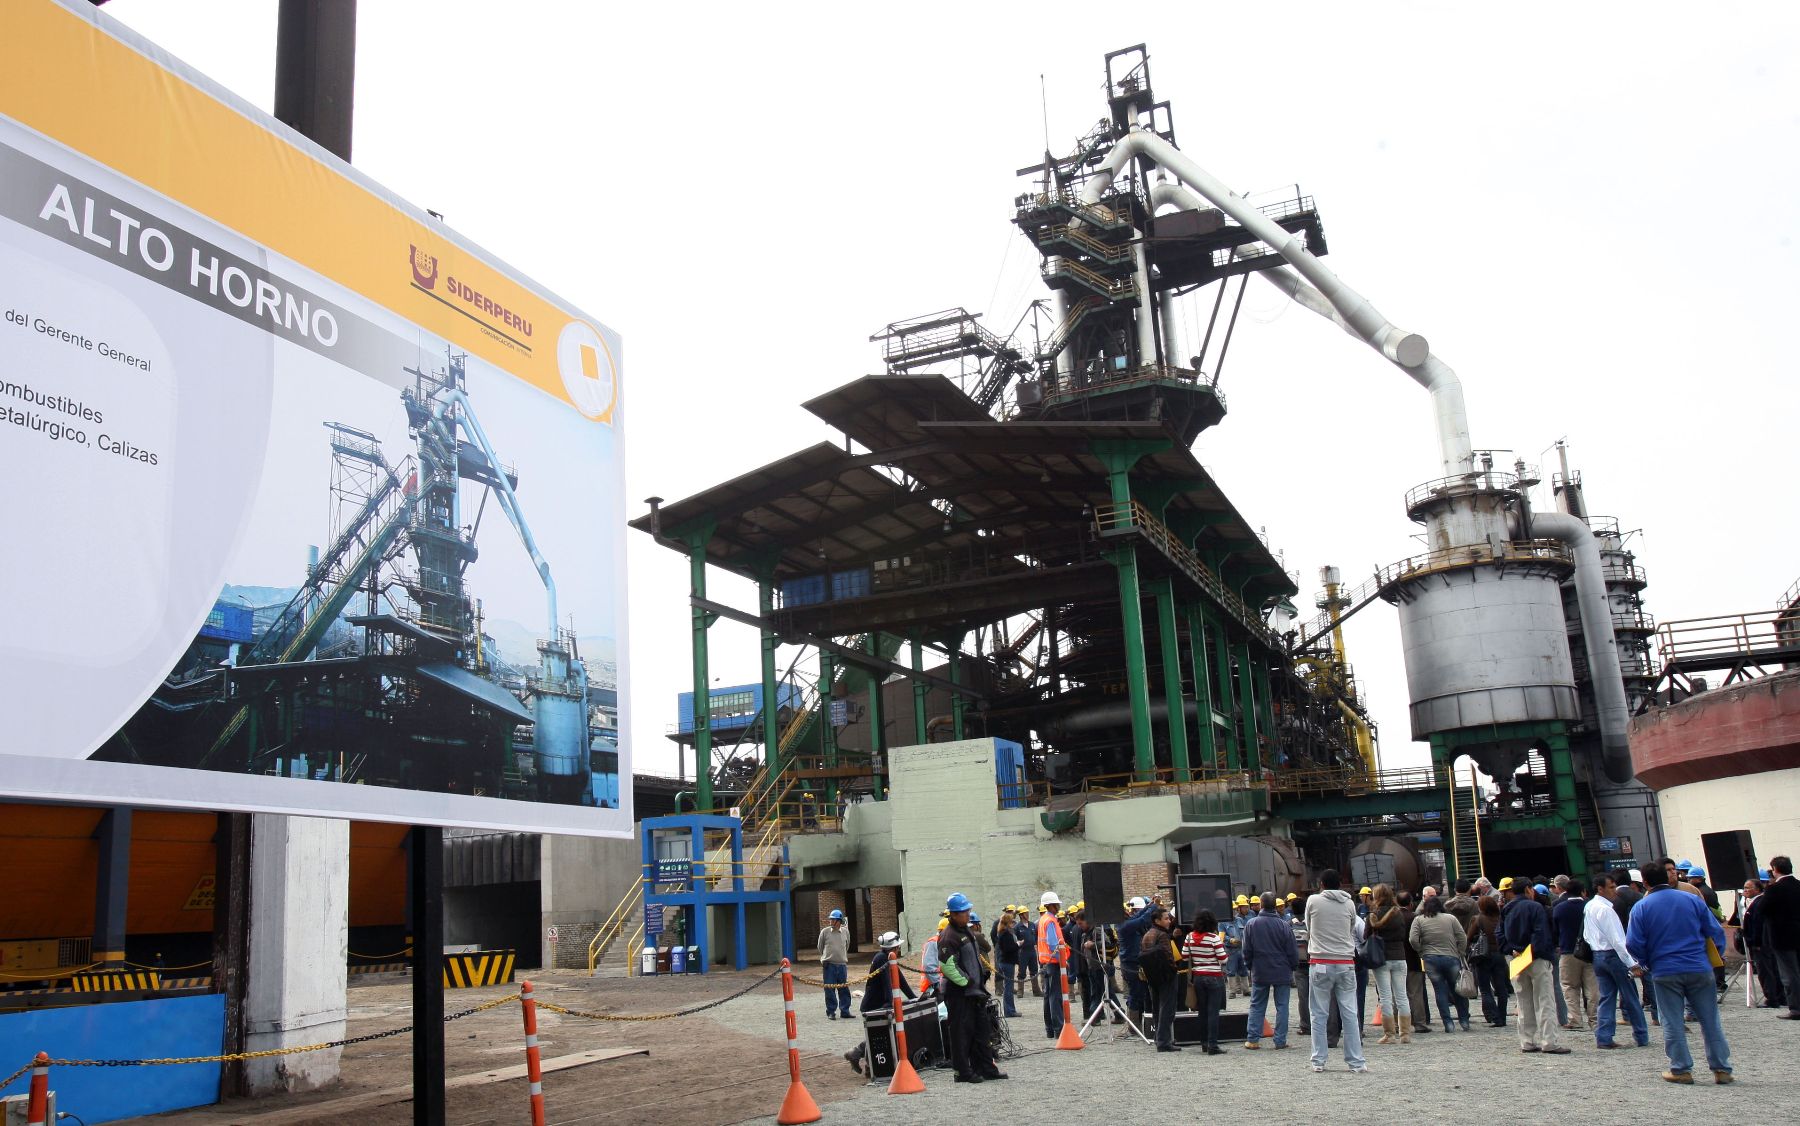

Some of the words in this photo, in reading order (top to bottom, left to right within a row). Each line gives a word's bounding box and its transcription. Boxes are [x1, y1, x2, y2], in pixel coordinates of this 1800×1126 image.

[38, 183, 174, 273] ALTO
[190, 247, 340, 347] HORNO
[447, 276, 533, 337] SIDERPERU
[5, 309, 29, 328] del
[33, 318, 93, 351] Gerente
[98, 342, 151, 373] General
[98, 434, 159, 466] Calizas
[875, 1052, 887, 1065] 15
